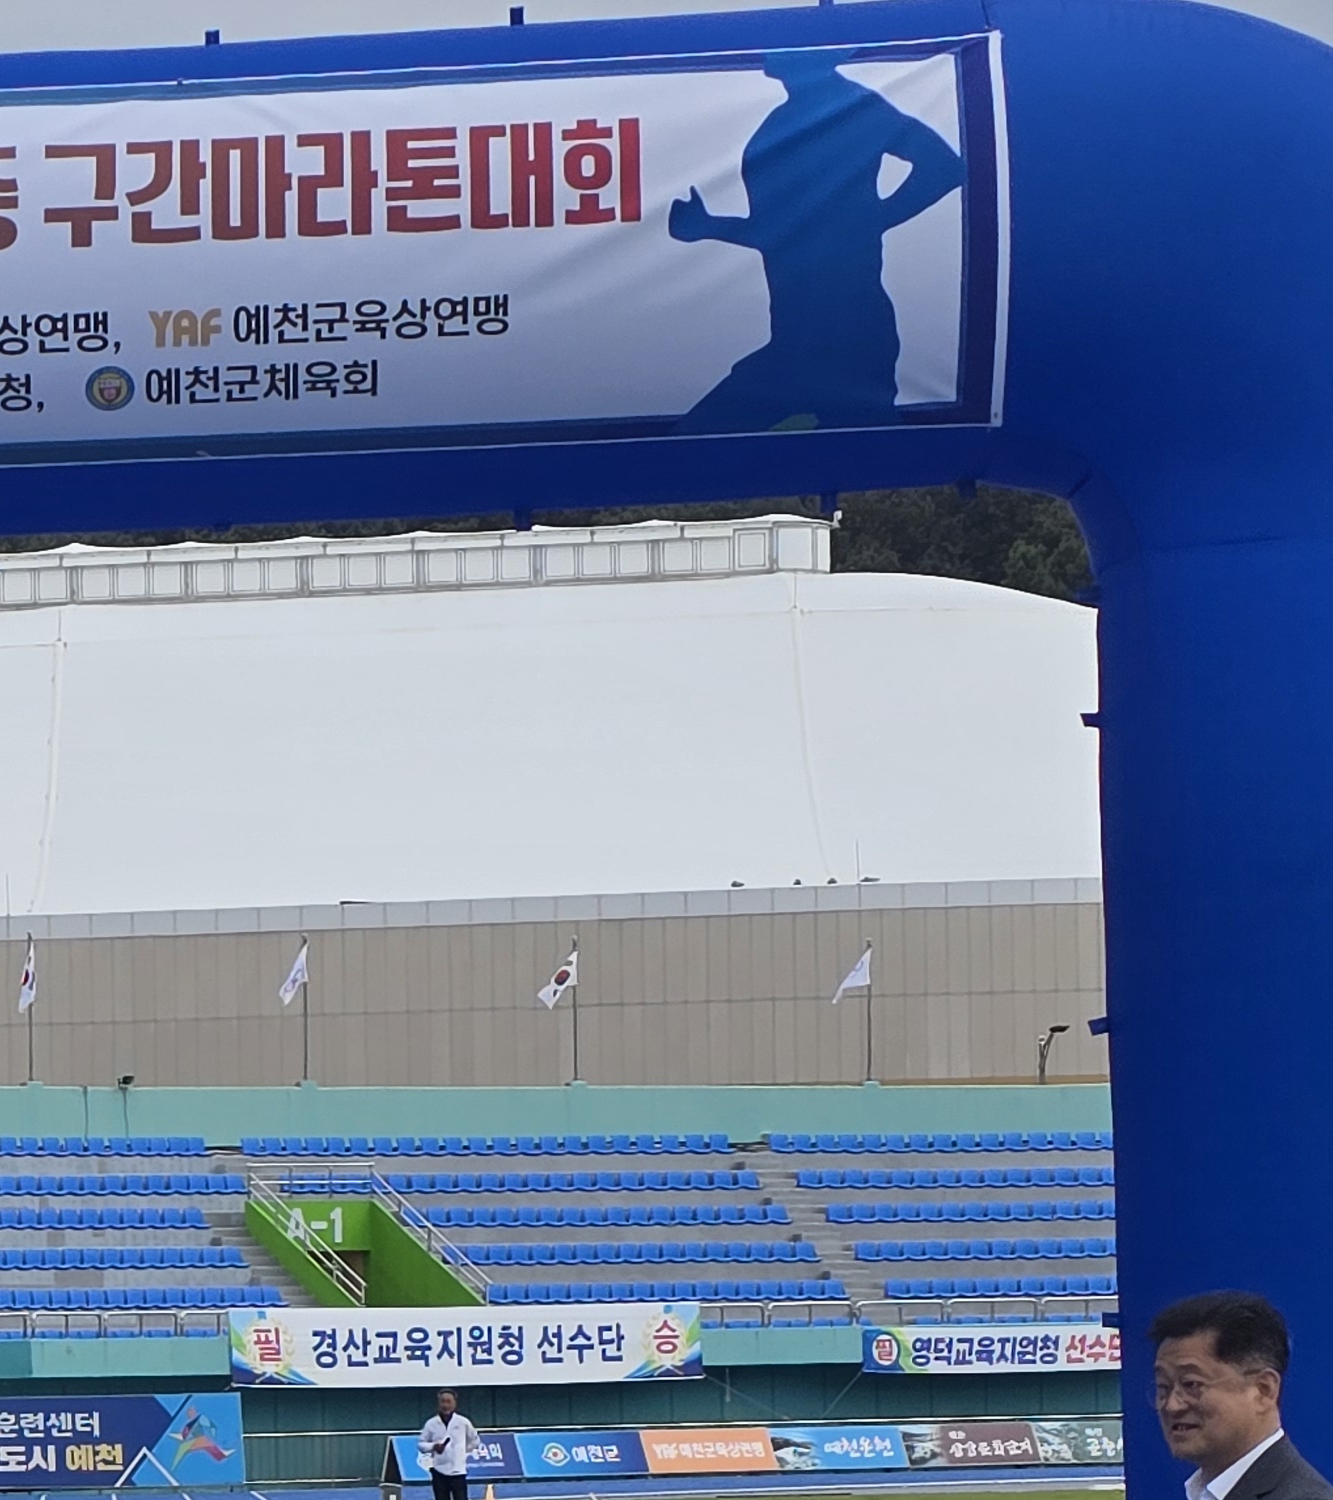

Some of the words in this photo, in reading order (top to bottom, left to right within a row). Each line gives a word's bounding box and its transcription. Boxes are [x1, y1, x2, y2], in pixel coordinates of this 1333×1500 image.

[43, 117, 642, 248] 구간마라톤대회
[148, 307, 223, 348] YAF
[232, 293, 511, 347] 예천군육상연맹
[144, 358, 380, 407] 예천군체육회
[287, 1206, 343, 1245] A-1
[252, 1327, 283, 1363] 필
[310, 1325, 525, 1368] 경산교육지원청
[537, 1322, 626, 1364] 선수단
[651, 1319, 682, 1355] 승
[910, 1335, 1060, 1366] 영덕교육지원청
[65, 1442, 124, 1472] 예천
